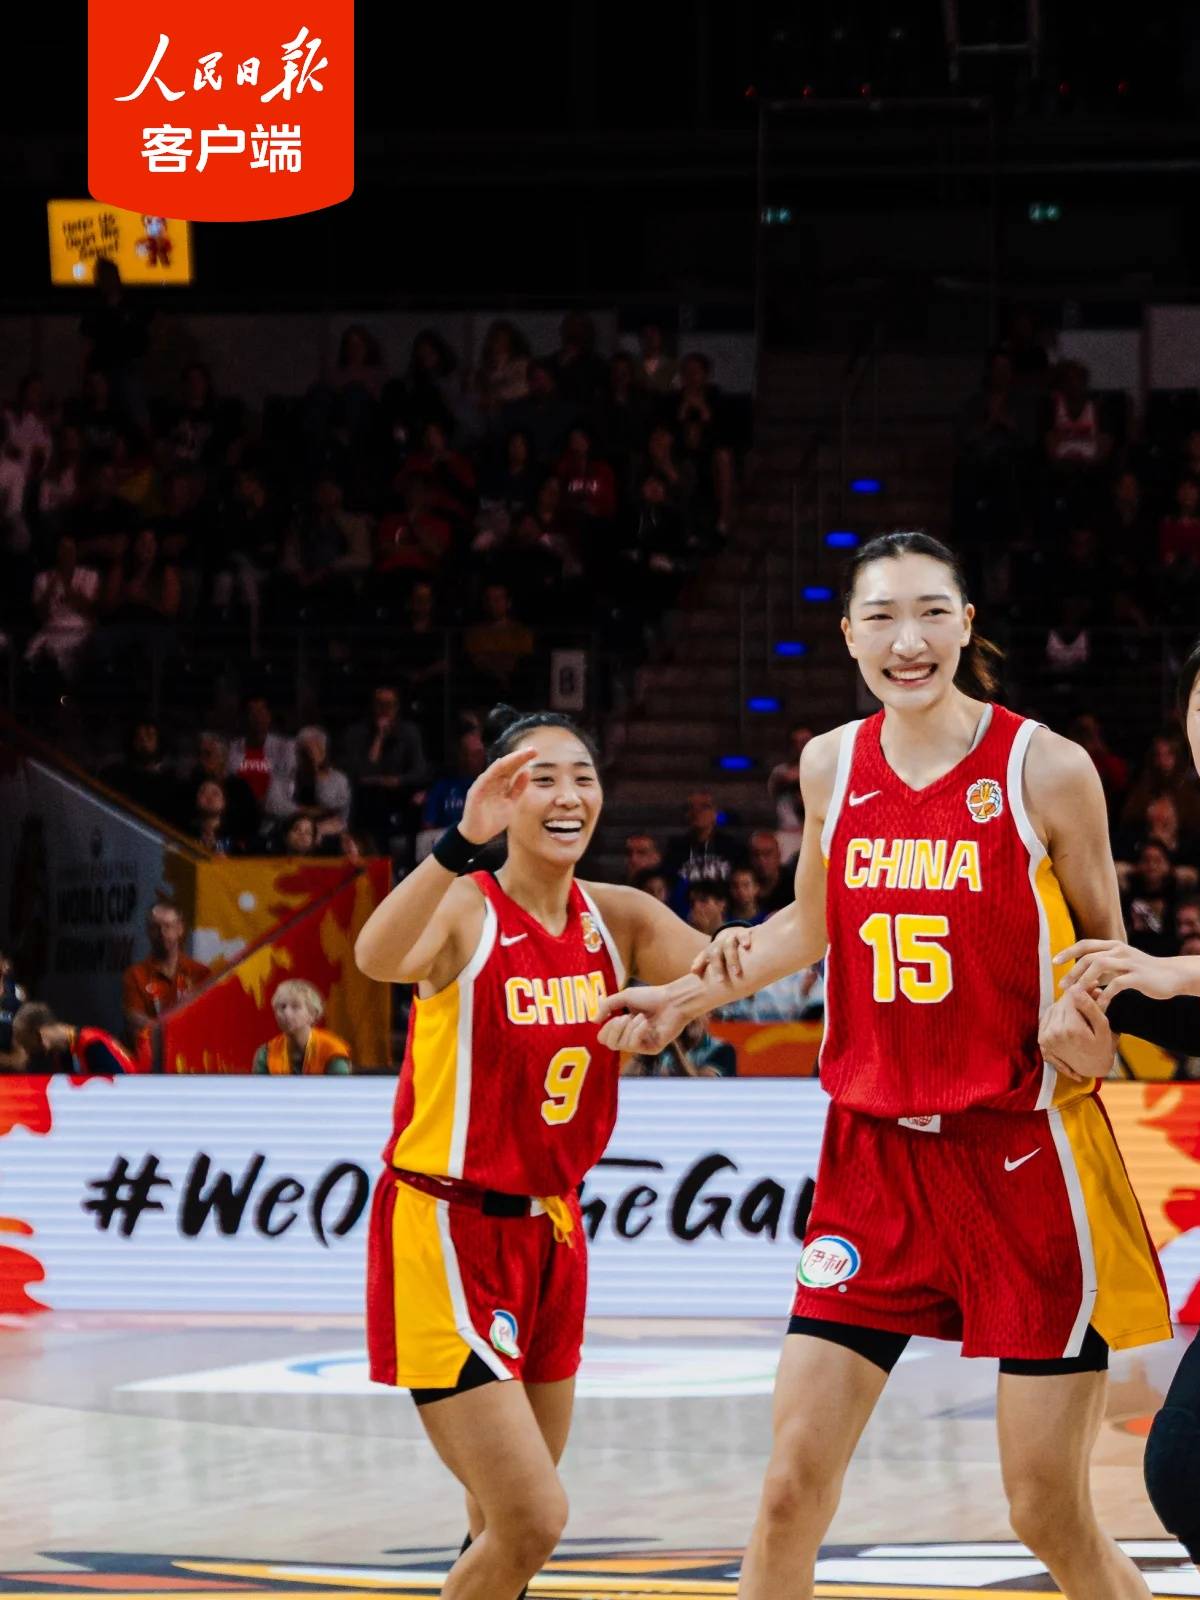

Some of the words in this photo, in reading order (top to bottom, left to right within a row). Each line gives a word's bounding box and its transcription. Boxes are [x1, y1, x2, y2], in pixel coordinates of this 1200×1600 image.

[845, 838, 983, 892] CHINA
[859, 913, 953, 1003] 15
[541, 1046, 591, 1126] 9
[803, 1248, 849, 1276] 伊利
